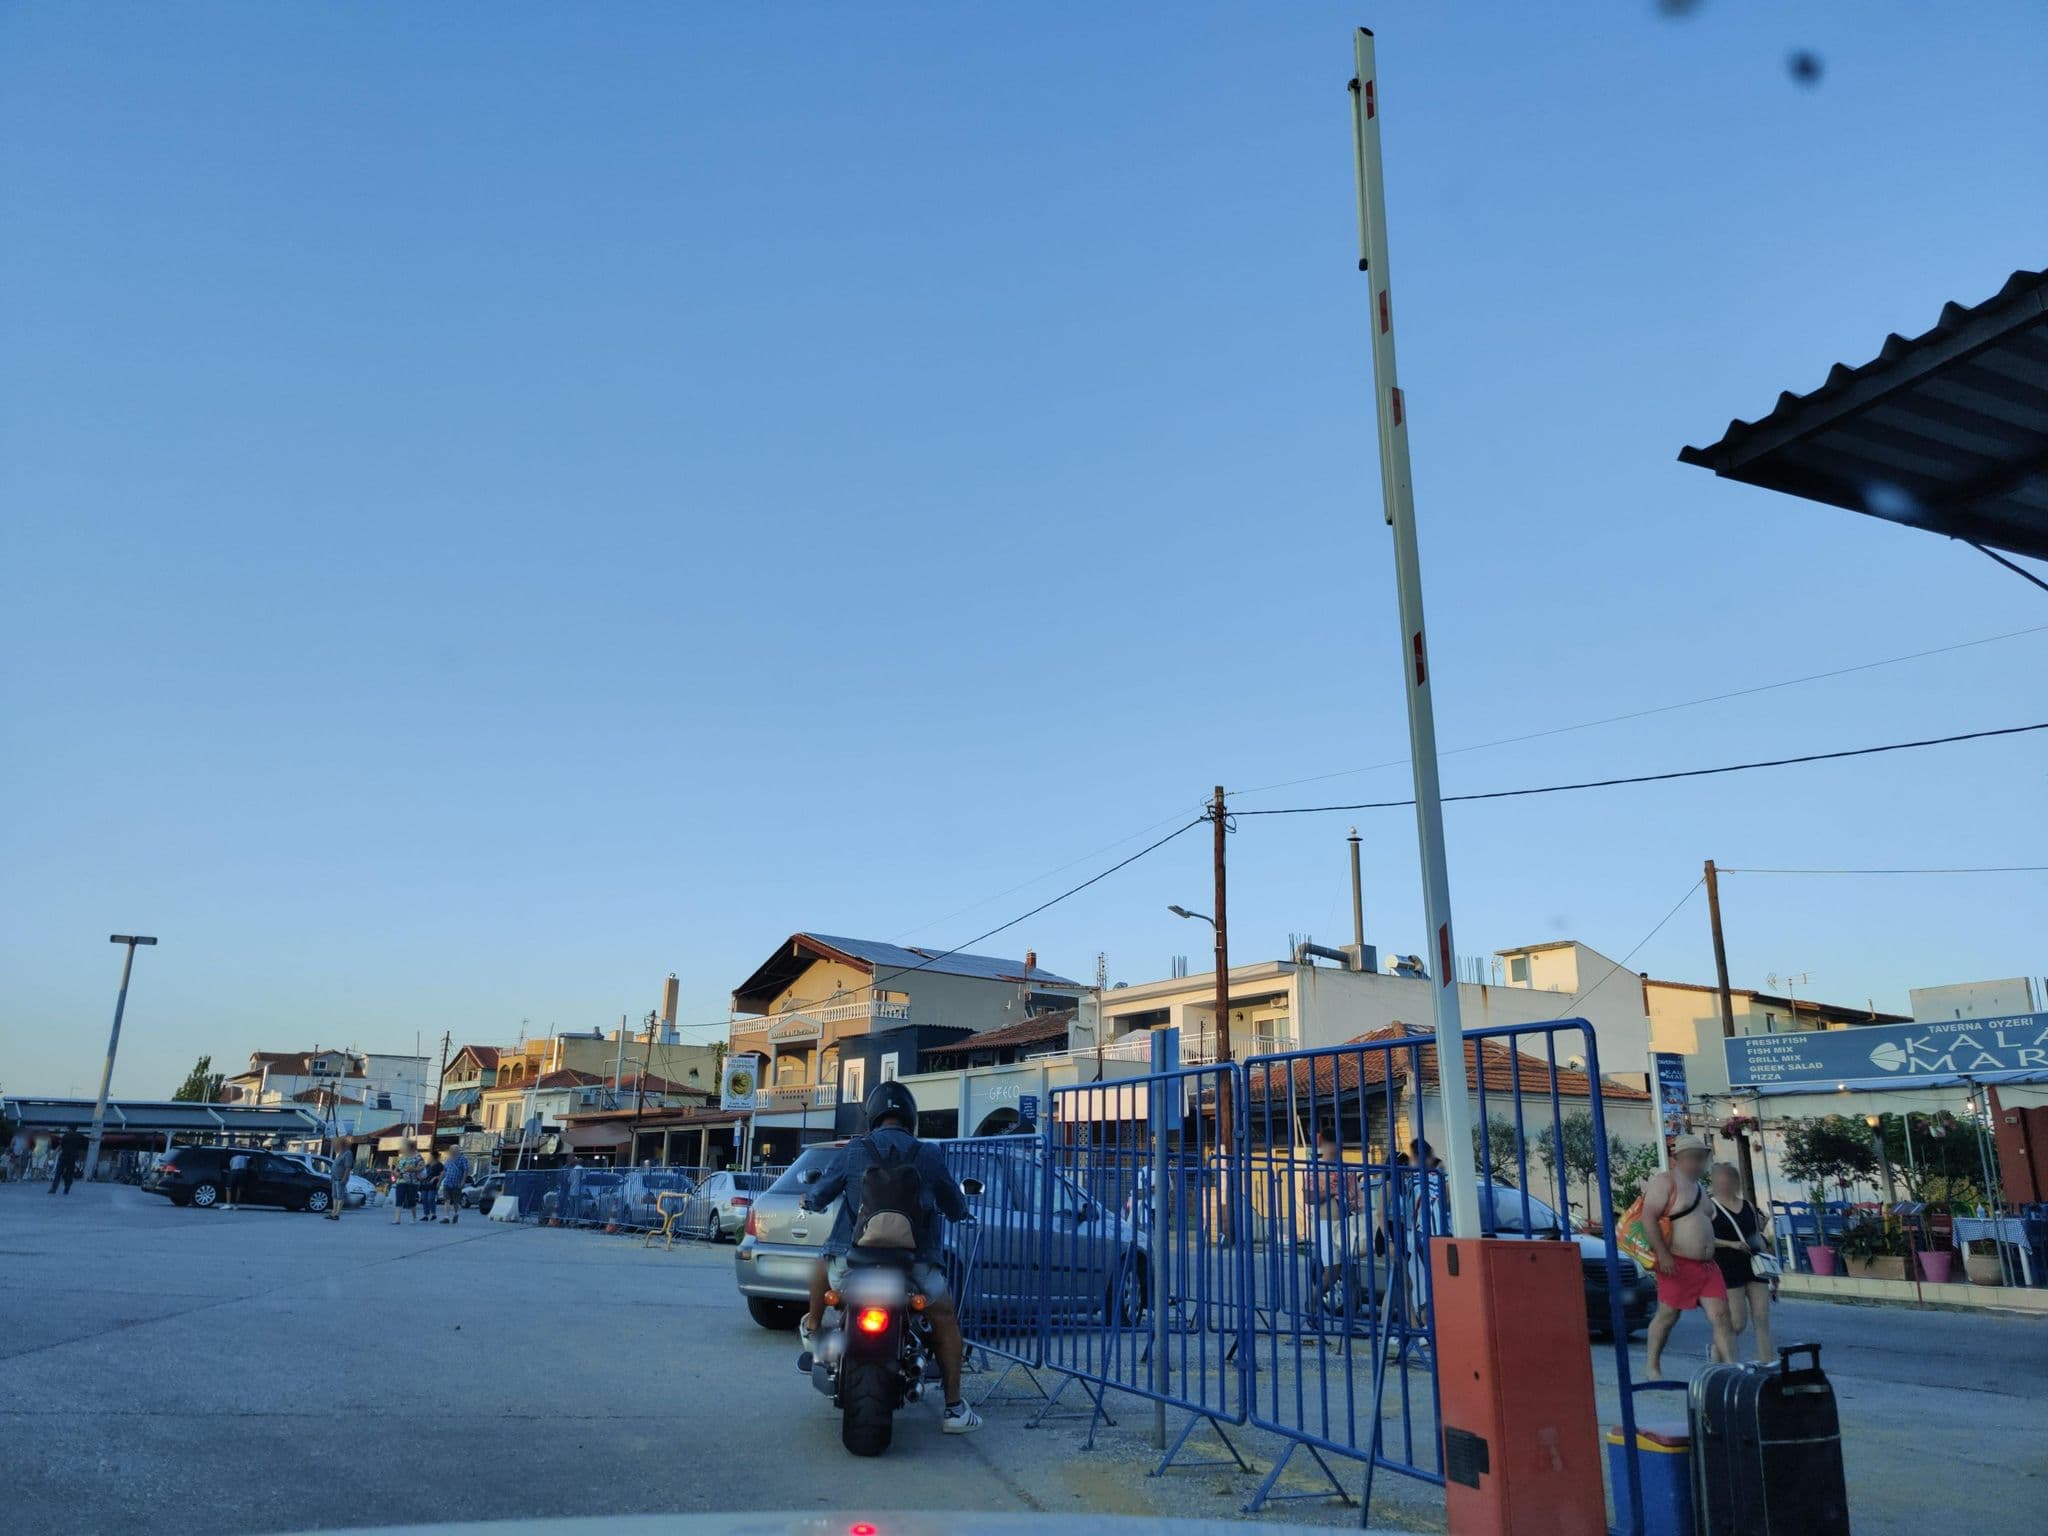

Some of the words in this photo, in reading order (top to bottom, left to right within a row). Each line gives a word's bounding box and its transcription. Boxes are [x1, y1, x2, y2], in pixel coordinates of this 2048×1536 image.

[1928, 1022, 1983, 1034] TAVERNA
[1988, 1017, 2034, 1029] OYZERI
[1745, 1038, 1780, 1047] FRESH
[1782, 1036, 1808, 1044] FISH
[1773, 1046, 1794, 1054] MIX
[1748, 1056, 1779, 1064] GRILL
[1781, 1054, 1802, 1062] MIX
[1749, 1064, 1785, 1072] GREEK
[1787, 1062, 1824, 1071] SALAD
[1750, 1073, 1782, 1081] PIZZA
